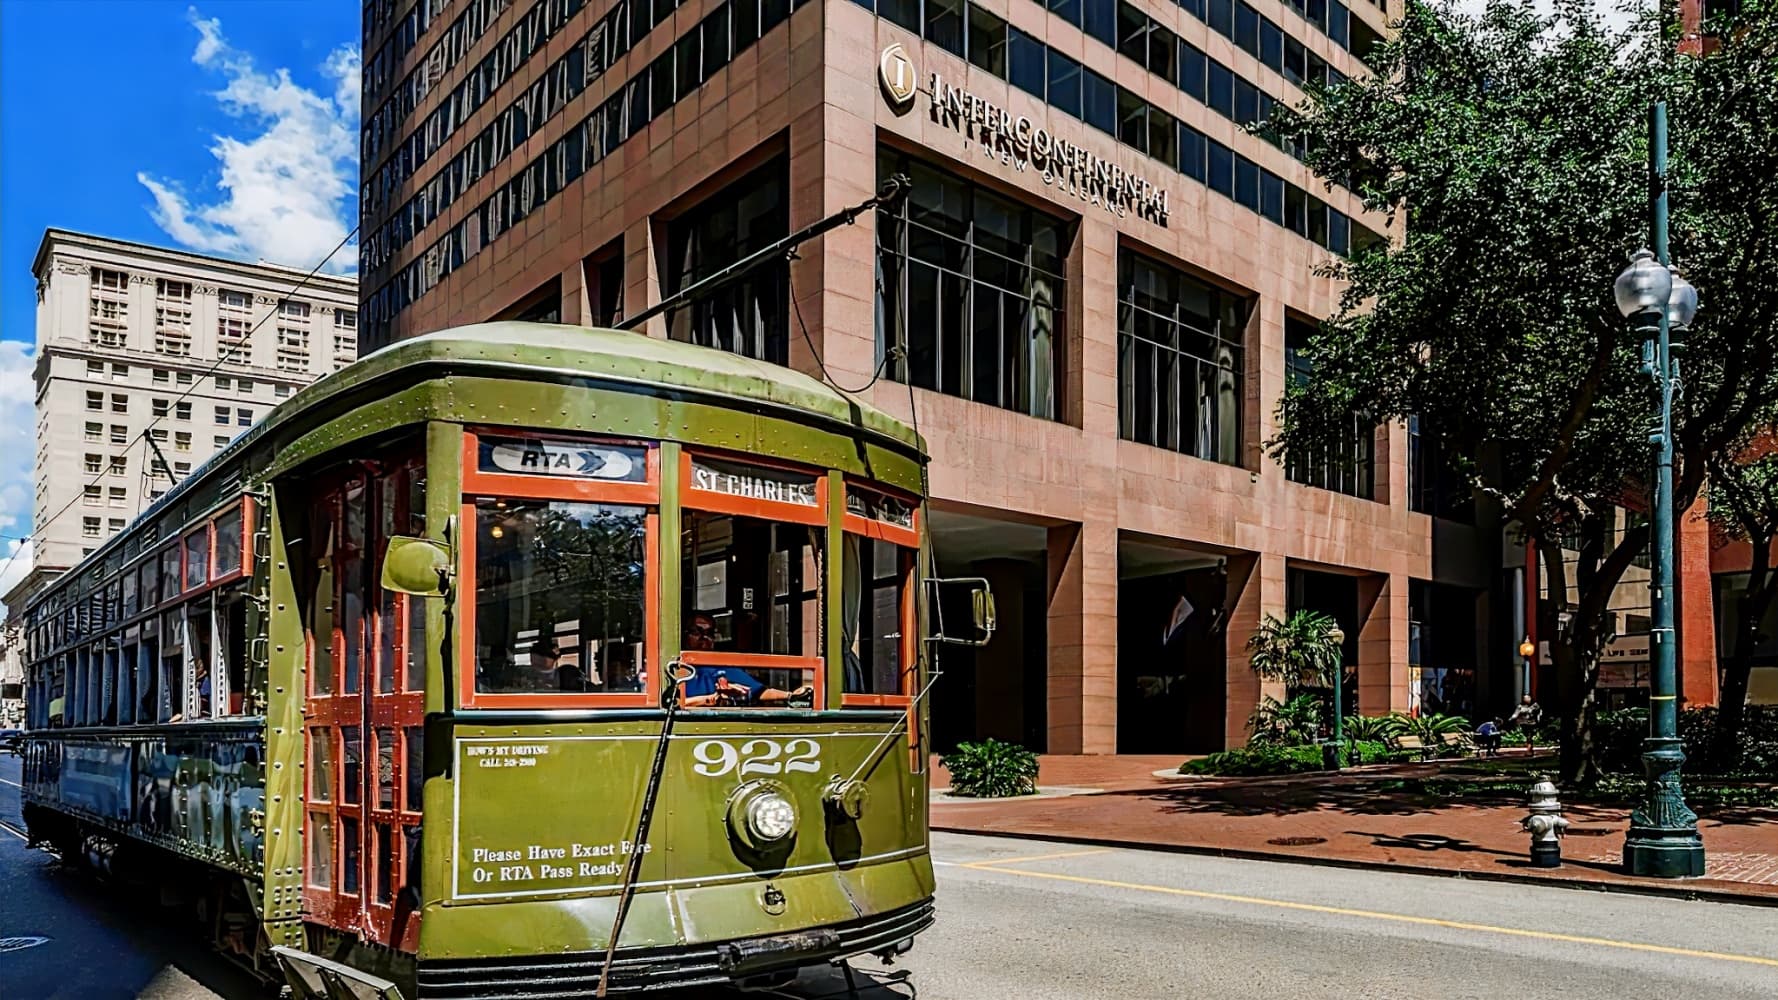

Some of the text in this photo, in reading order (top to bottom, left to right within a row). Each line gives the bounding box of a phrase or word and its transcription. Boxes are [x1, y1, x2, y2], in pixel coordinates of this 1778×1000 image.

[931, 73, 1172, 215] INTERCONTINENTAL
[984, 142, 1028, 173] NEW
[521, 451, 571, 469] RTA
[728, 475, 809, 505] CHARLES
[693, 739, 821, 777] 922
[473, 848, 521, 863] Please
[528, 845, 566, 860] Have
[572, 842, 615, 858] Exact
[473, 861, 625, 883] Or RTA Pass Ready
